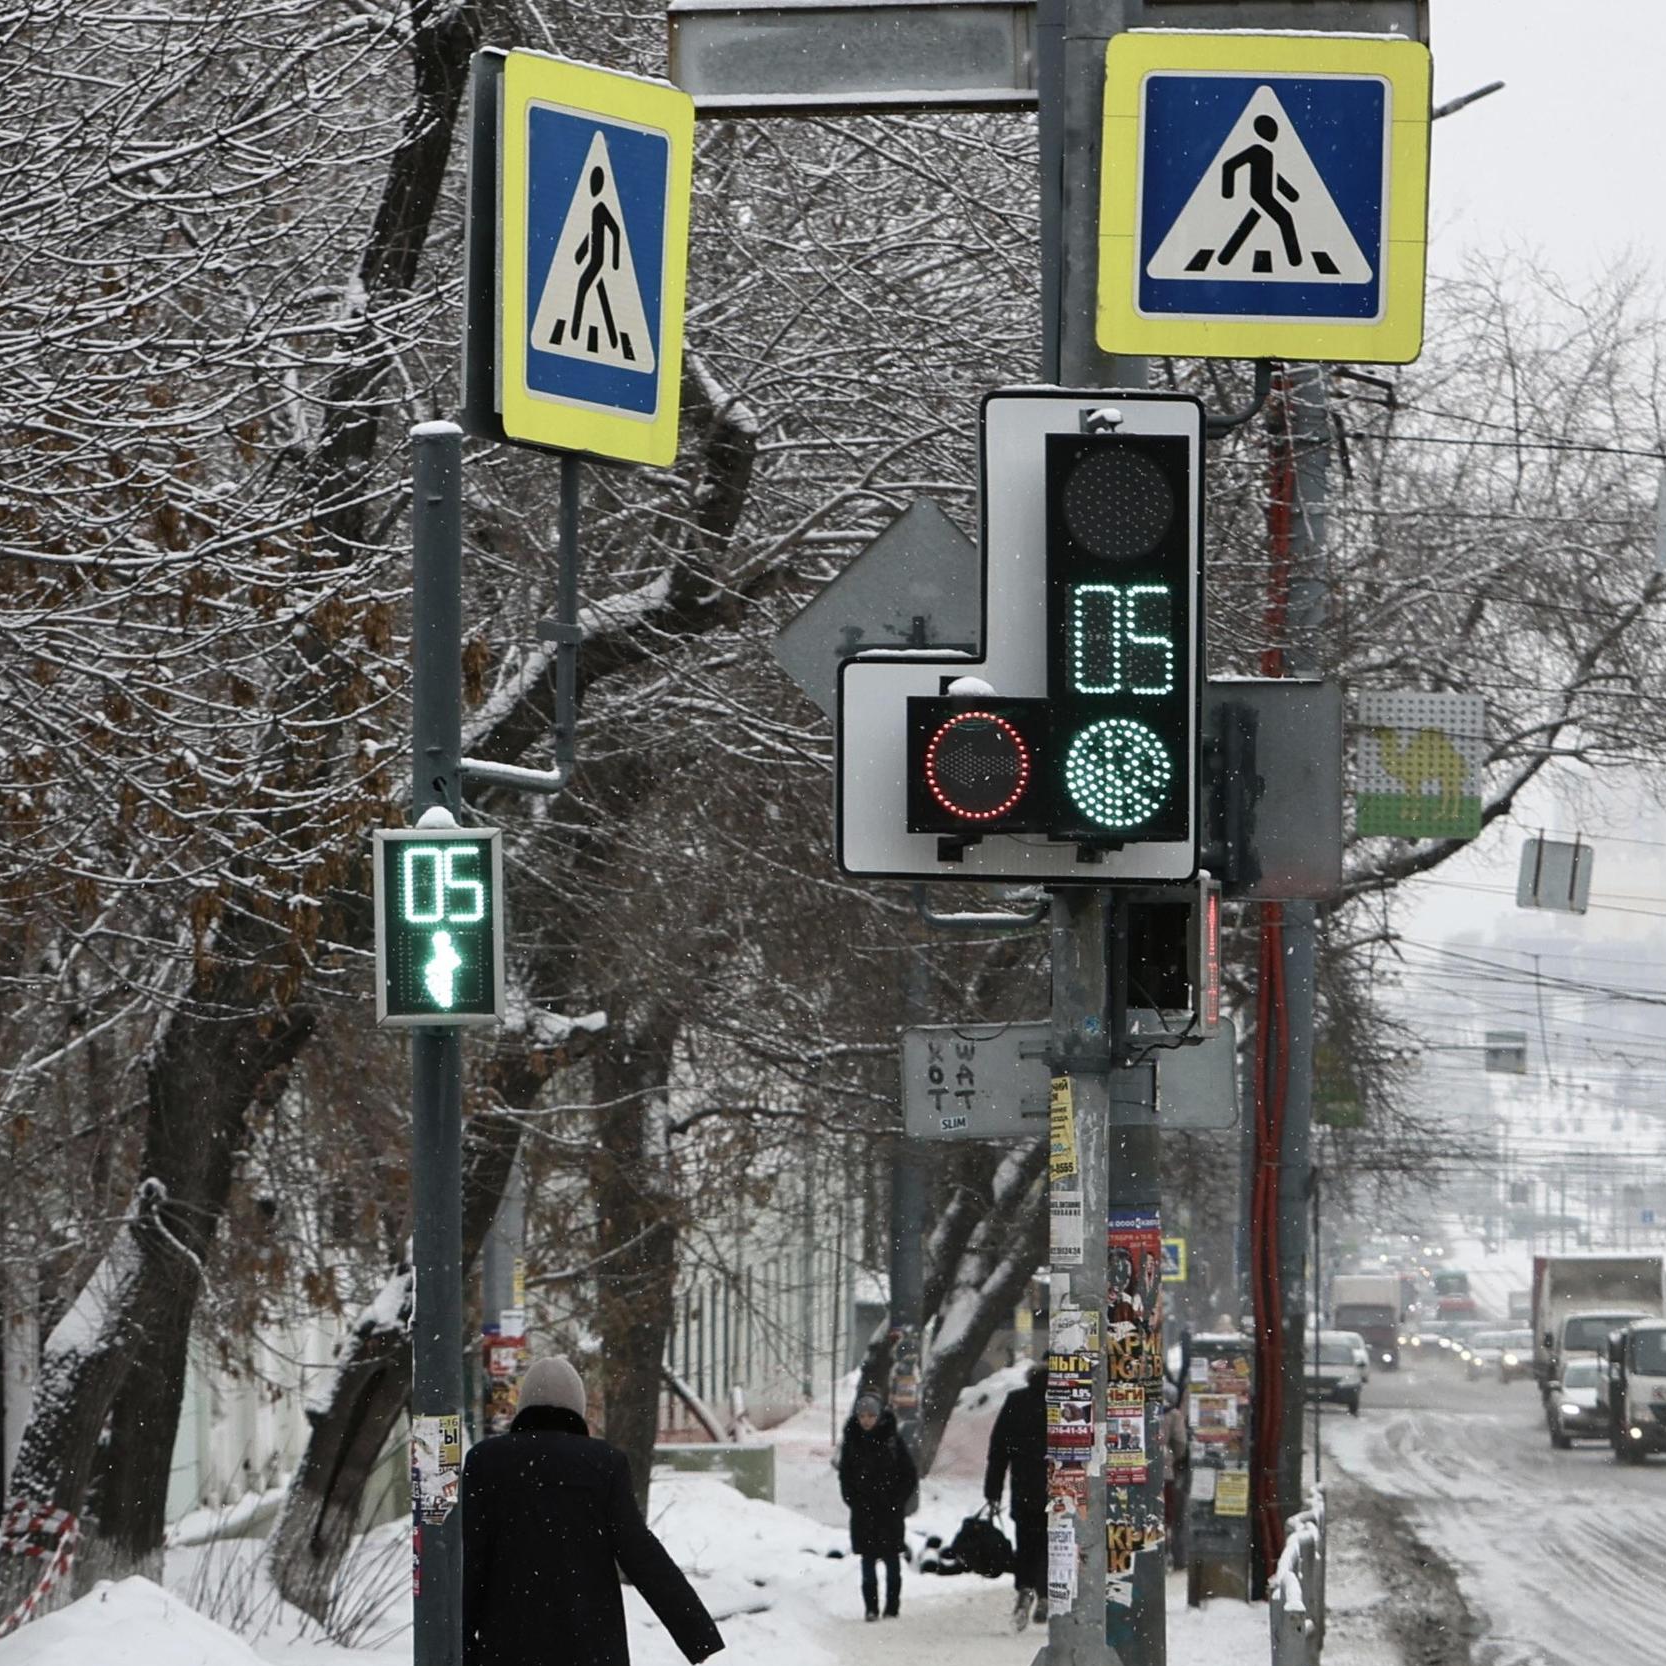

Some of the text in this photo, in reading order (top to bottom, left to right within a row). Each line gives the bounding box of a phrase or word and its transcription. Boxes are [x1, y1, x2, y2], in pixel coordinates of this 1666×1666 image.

[1071, 583, 1175, 695] 05
[403, 846, 485, 923] 05
[941, 1117, 967, 1131] SLIM
[1049, 1356, 1090, 1372] НЬГИ
